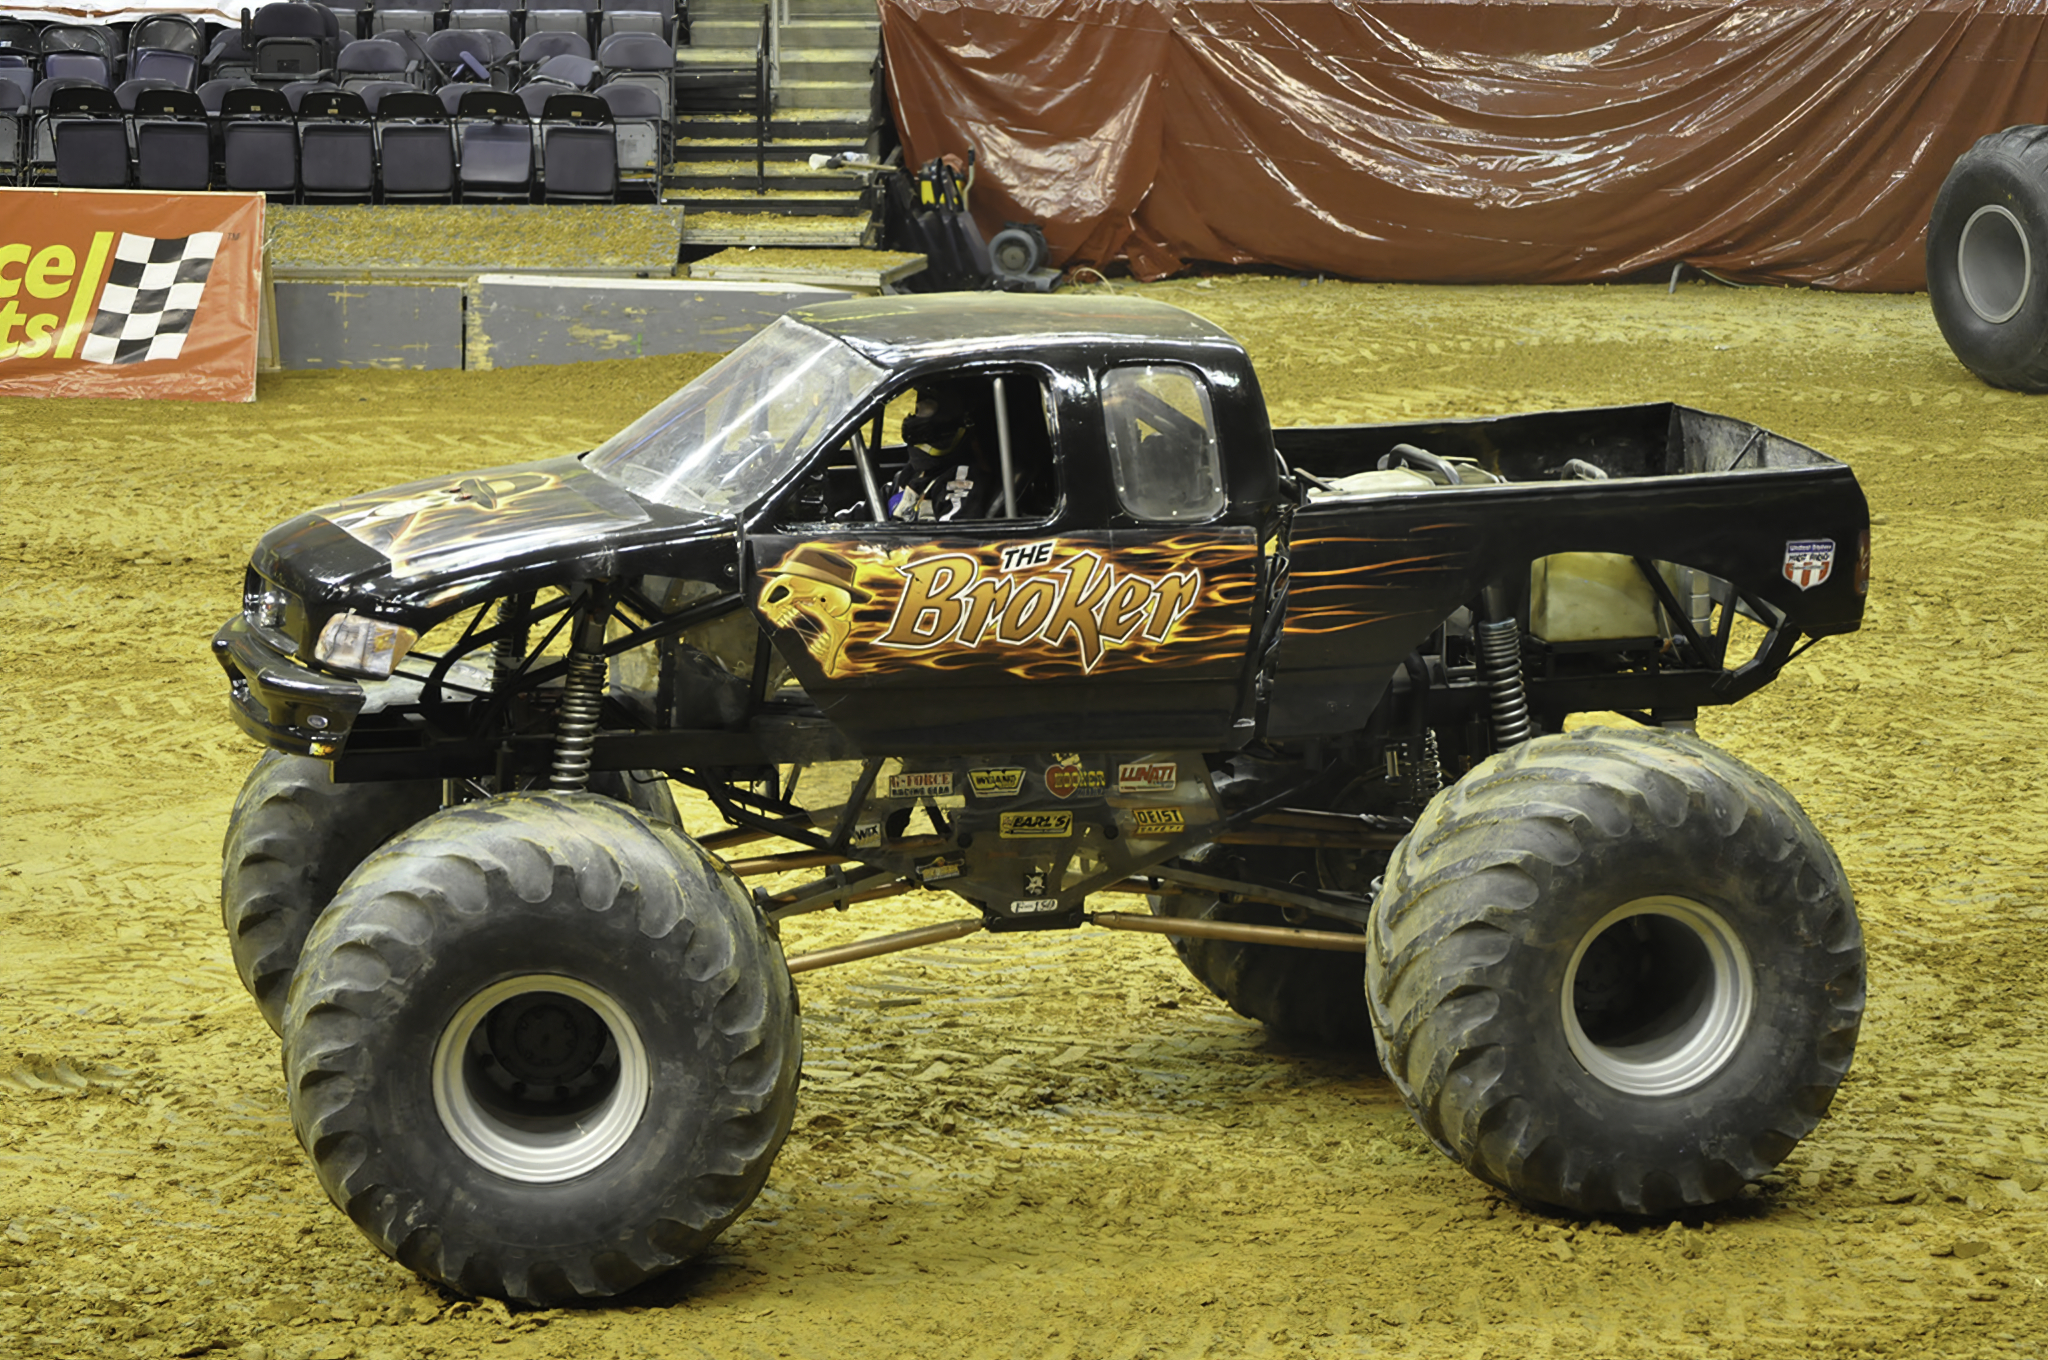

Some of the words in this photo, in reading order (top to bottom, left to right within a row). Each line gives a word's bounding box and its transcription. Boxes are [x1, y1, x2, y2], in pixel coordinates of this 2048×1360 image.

[1003, 542, 1052, 571] THE
[870, 549, 1201, 674] Broker
[1013, 815, 1068, 828] EARL'S
[1138, 809, 1182, 825] DEIST
